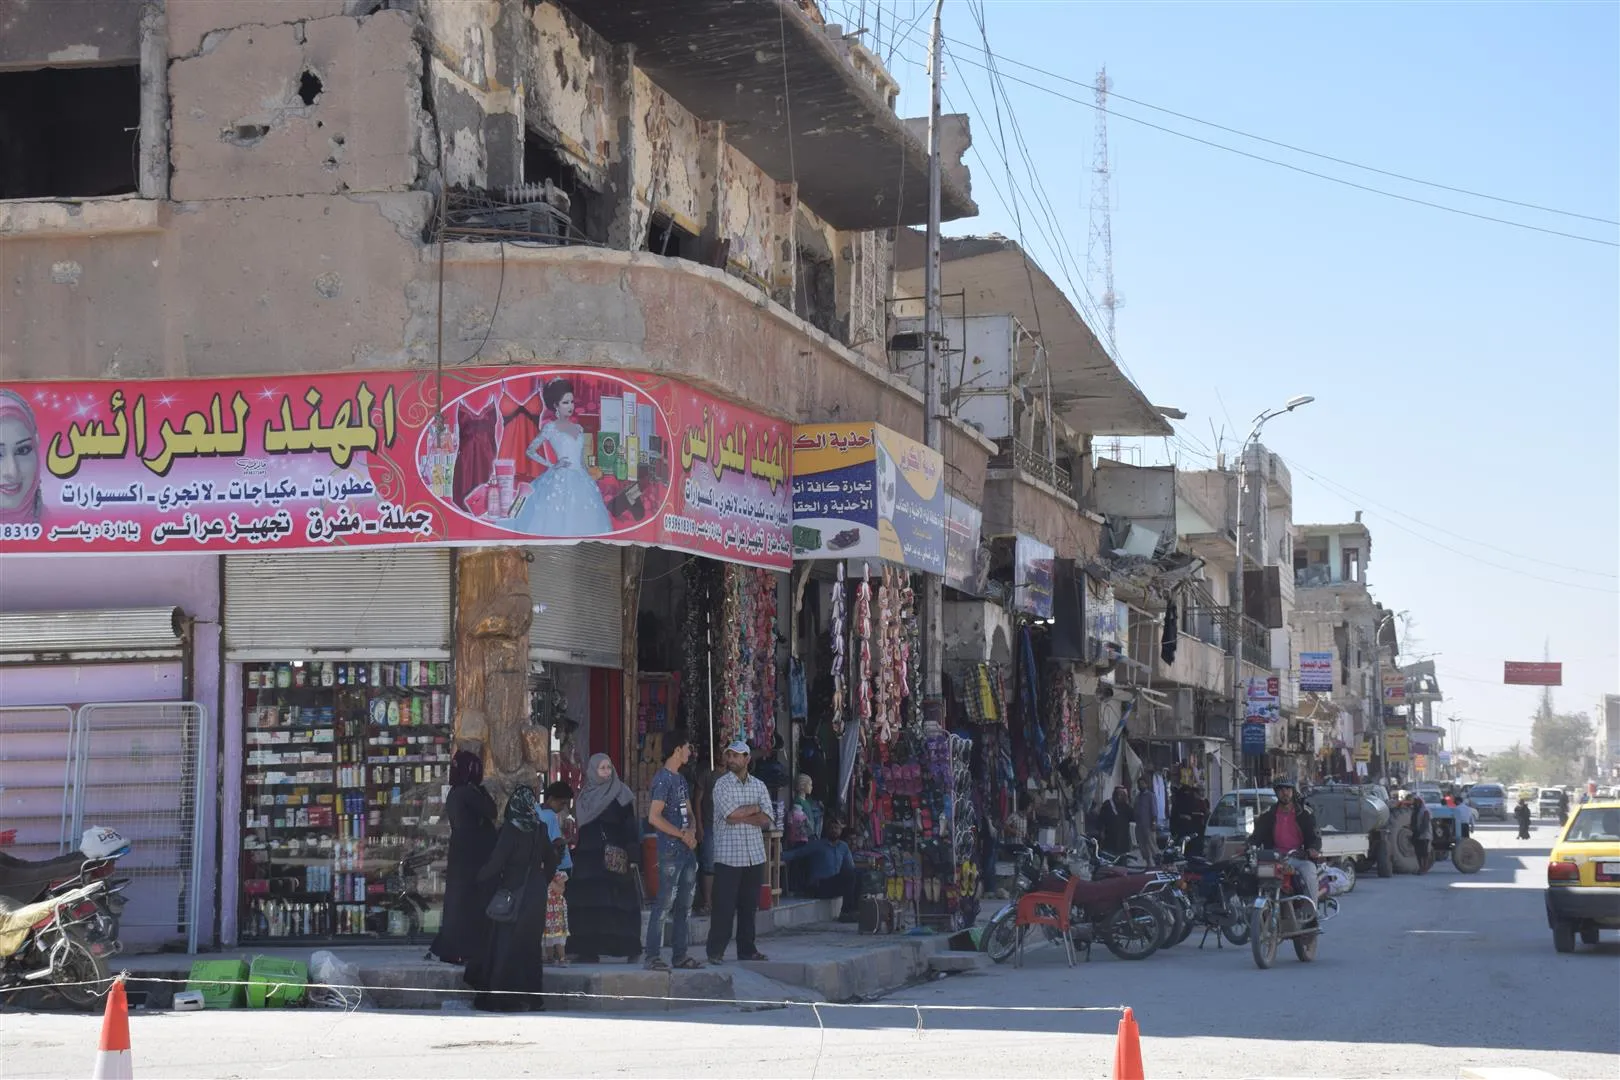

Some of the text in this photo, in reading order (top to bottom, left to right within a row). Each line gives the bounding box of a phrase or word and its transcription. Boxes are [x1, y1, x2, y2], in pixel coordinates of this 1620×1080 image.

[46, 381, 396, 480] المهند للعرائس
[829, 428, 875, 452] أحذية
[681, 404, 790, 495] المهند للعرائس
[62, 477, 373, 509] عطورات مكياجات لانجري اكسسوارات
[807, 481, 840, 492] كافة
[842, 480, 872, 494] تجارة
[830, 496, 873, 513] الأحذية
[49, 521, 91, 540] ياسر
[153, 514, 224, 541] عرائس
[228, 511, 291, 540] تجهيز
[308, 508, 360, 540] مفرق
[380, 505, 431, 533] جملة
